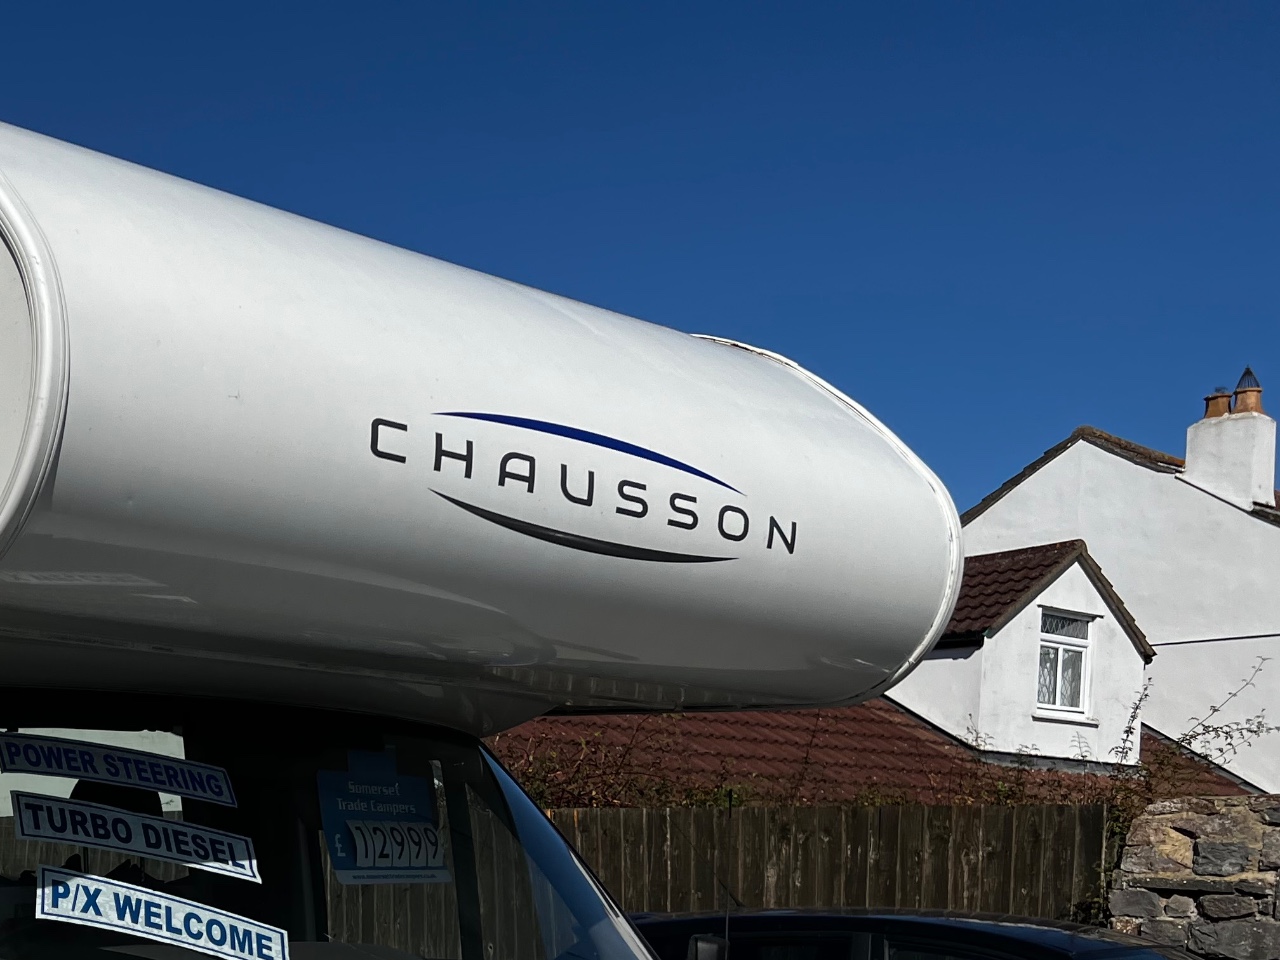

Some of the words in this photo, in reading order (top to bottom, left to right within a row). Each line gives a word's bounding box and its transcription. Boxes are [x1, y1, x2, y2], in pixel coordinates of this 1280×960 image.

[370, 417, 797, 554] CHAUSSON
[7, 741, 99, 775] POWER
[105, 755, 224, 797] STEERING
[348, 781, 401, 796] Somerset
[336, 797, 368, 812] Trade
[370, 800, 417, 815] Campers
[24, 804, 134, 845] TURBO
[144, 824, 250, 871] DIESEL
[50, 879, 101, 917] P/X
